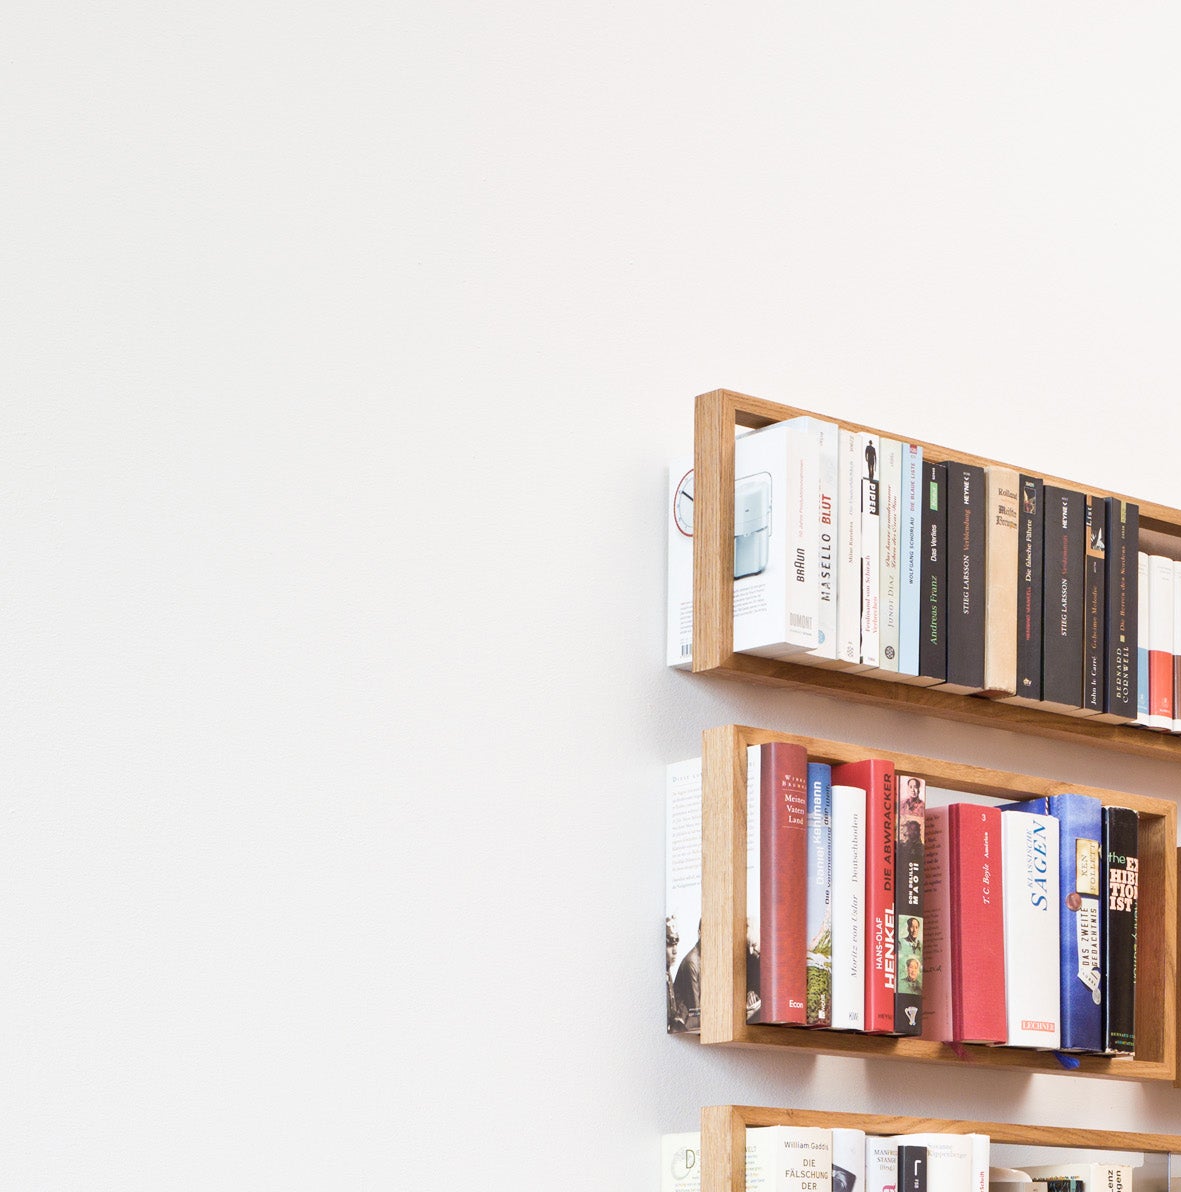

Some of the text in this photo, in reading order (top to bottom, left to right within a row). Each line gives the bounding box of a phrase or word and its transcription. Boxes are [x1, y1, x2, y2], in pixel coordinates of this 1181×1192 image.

[869, 480, 878, 514] PIPER
[821, 493, 831, 602] MASELLO BLUT
[794, 548, 805, 582] BRAUN
[962, 555, 970, 590] LARSSON
[1024, 570, 1033, 581] Die
[929, 524, 938, 645] Andreas Franz Das Verlies
[962, 592, 970, 614] STIEG
[1090, 687, 1098, 705] John
[789, 815, 804, 825] Land
[812, 781, 825, 885] Daniel Kehlmann
[883, 774, 892, 891] DIE ABWRACKER
[1031, 820, 1047, 911] SAGEN
[1108, 851, 1126, 864] the
[982, 863, 991, 885] Boyle
[1110, 896, 1133, 912] IST
[884, 903, 895, 989] HENKEL
[1080, 907, 1090, 966] DAS ZWEITE
[789, 999, 804, 1009] Econ
[784, 1141, 810, 1149] William
[785, 1168, 829, 1180] FÄLSCHUNG
[803, 1159, 816, 1167] DIE
[801, 1182, 817, 1190] DER
